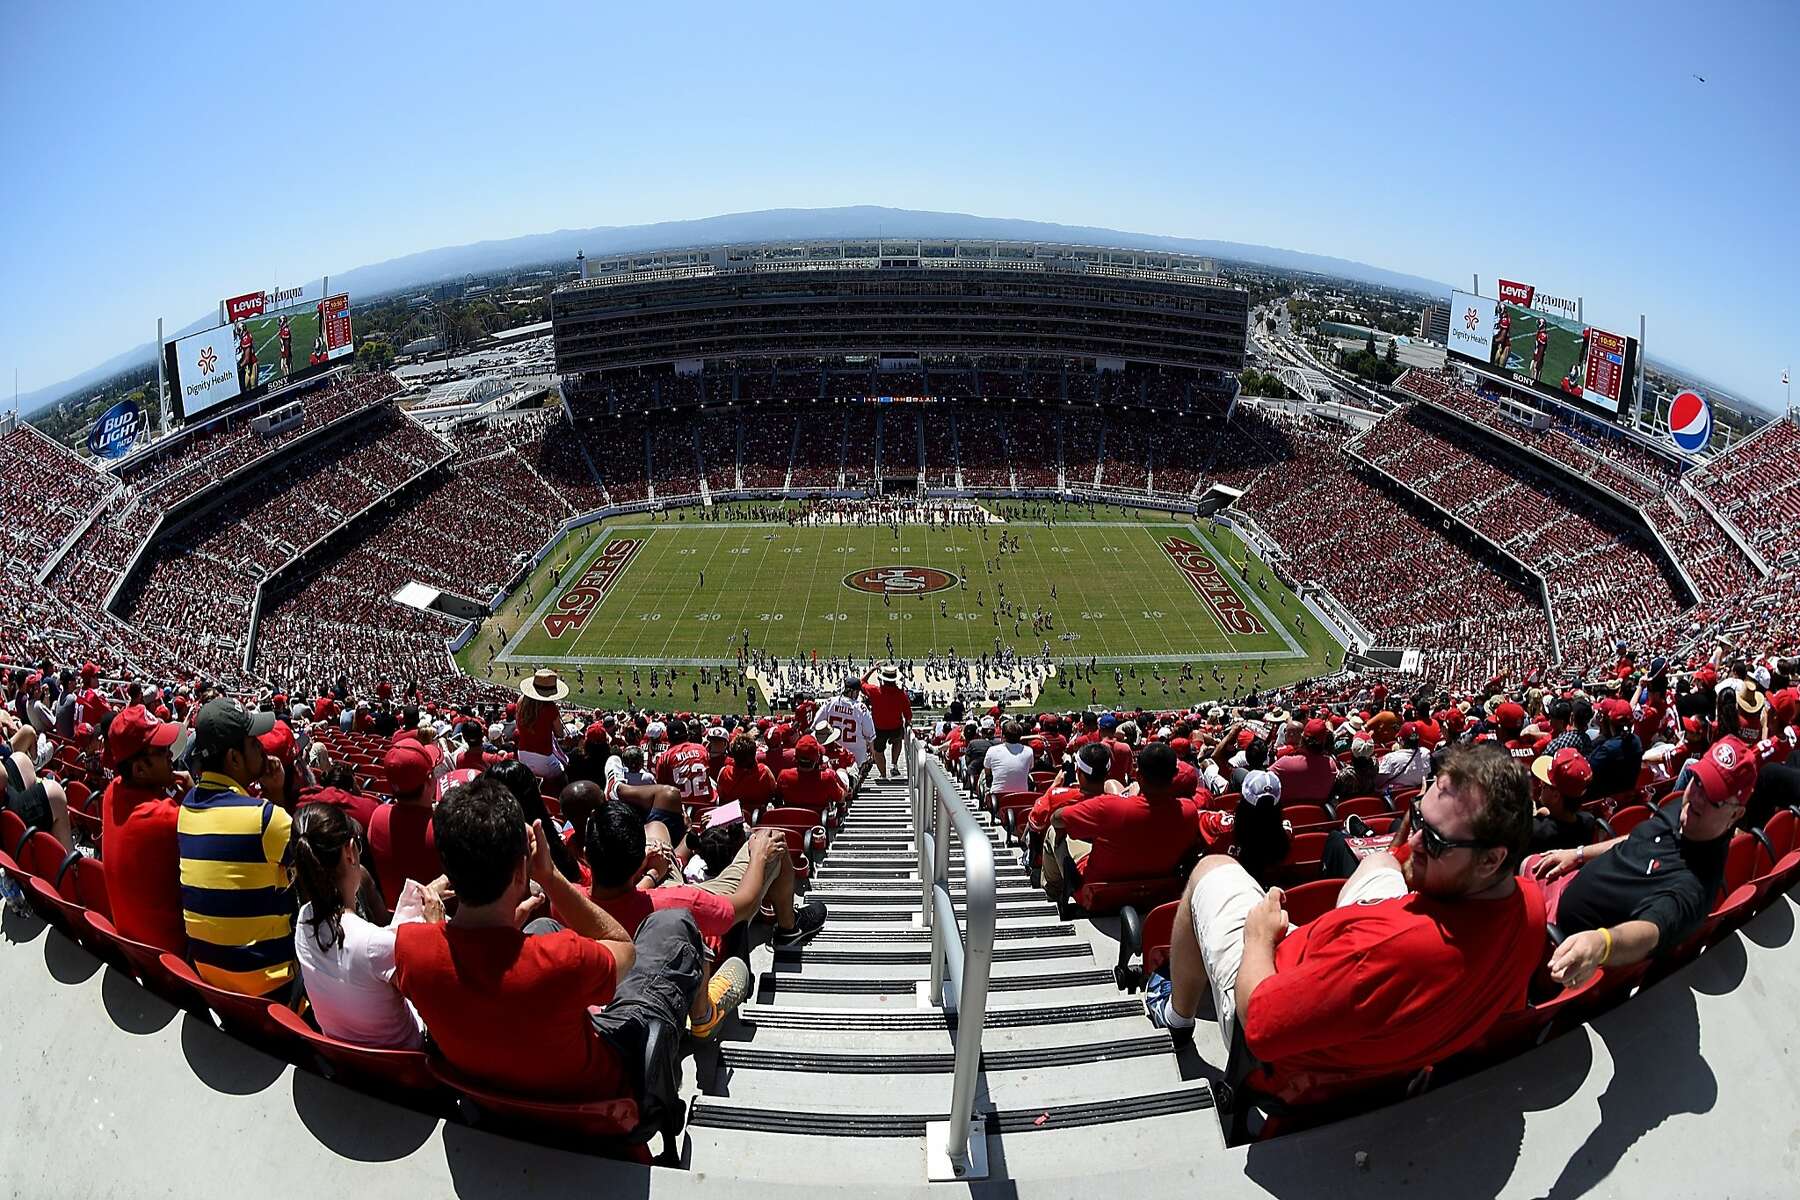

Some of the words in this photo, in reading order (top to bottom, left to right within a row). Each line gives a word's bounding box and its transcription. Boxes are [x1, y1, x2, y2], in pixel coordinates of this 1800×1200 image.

[264, 287, 304, 305] STADIUM
[1535, 293, 1576, 312] STADIUM
[1452, 328, 1470, 342] Dignity
[1470, 334, 1488, 347] Health
[1600, 336, 1617, 348] 10:50
[186, 380, 211, 396] Dignity
[211, 370, 233, 386] Health
[267, 376, 289, 390] SONY
[1512, 372, 1535, 387] SONY
[104, 411, 134, 434] BUD
[99, 420, 138, 449] LIGHT
[541, 538, 645, 639] 49ERS
[1160, 536, 1269, 635] 49ERS
[698, 612, 722, 621] 20
[760, 612, 784, 621] 30
[824, 612, 849, 621] 40
[888, 612, 913, 621] 50
[954, 612, 978, 621] 40
[1080, 611, 1103, 620] 20
[1142, 611, 1164, 619] 10
[834, 704, 854, 716] WILLIS
[675, 748, 700, 761] WILLIS
[1510, 747, 1535, 758] GARCIA
[672, 762, 710, 798] 52
